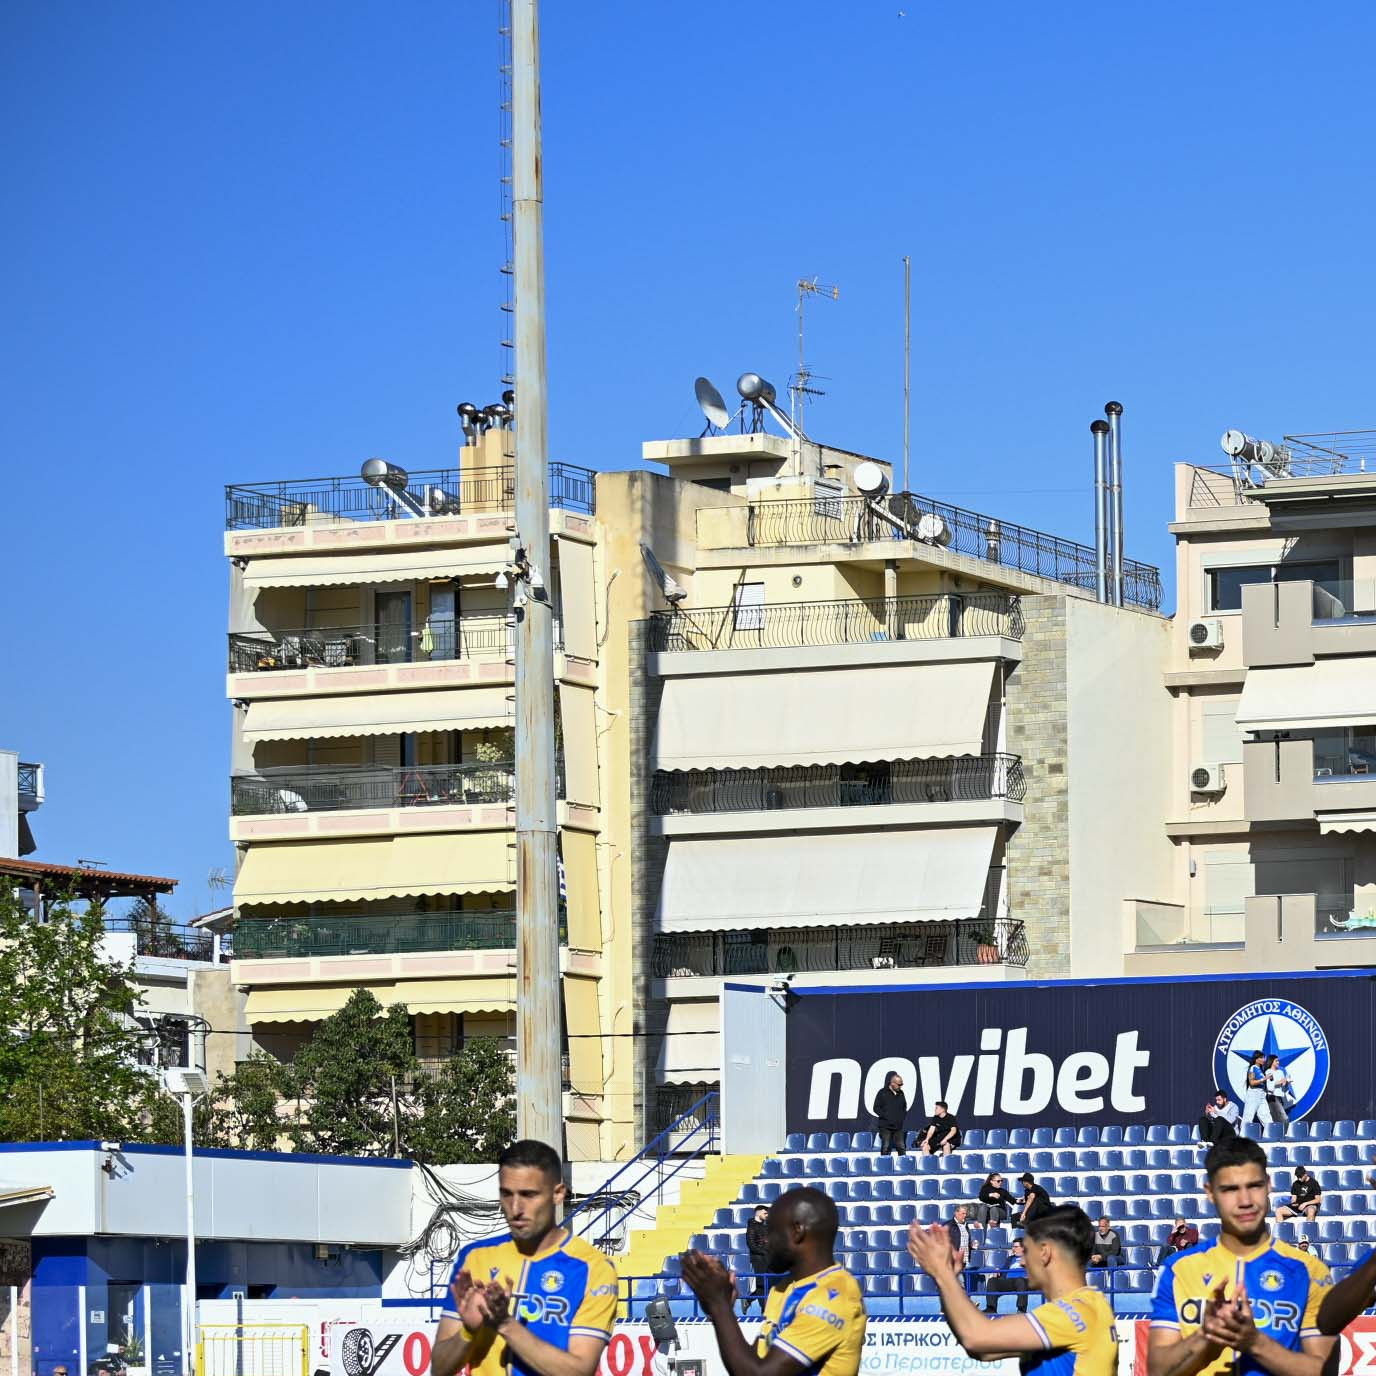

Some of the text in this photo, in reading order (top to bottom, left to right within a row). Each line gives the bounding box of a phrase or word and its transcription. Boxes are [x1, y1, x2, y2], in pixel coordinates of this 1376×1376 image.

[1218, 1001, 1281, 1055] ΑΤΡΟΜΗΤΟΣ
[807, 1027, 1150, 1120] novibet
[511, 1291, 570, 1327] TOR
[881, 1332, 953, 1348] ΙΑΤΡΙΚΟΥ
